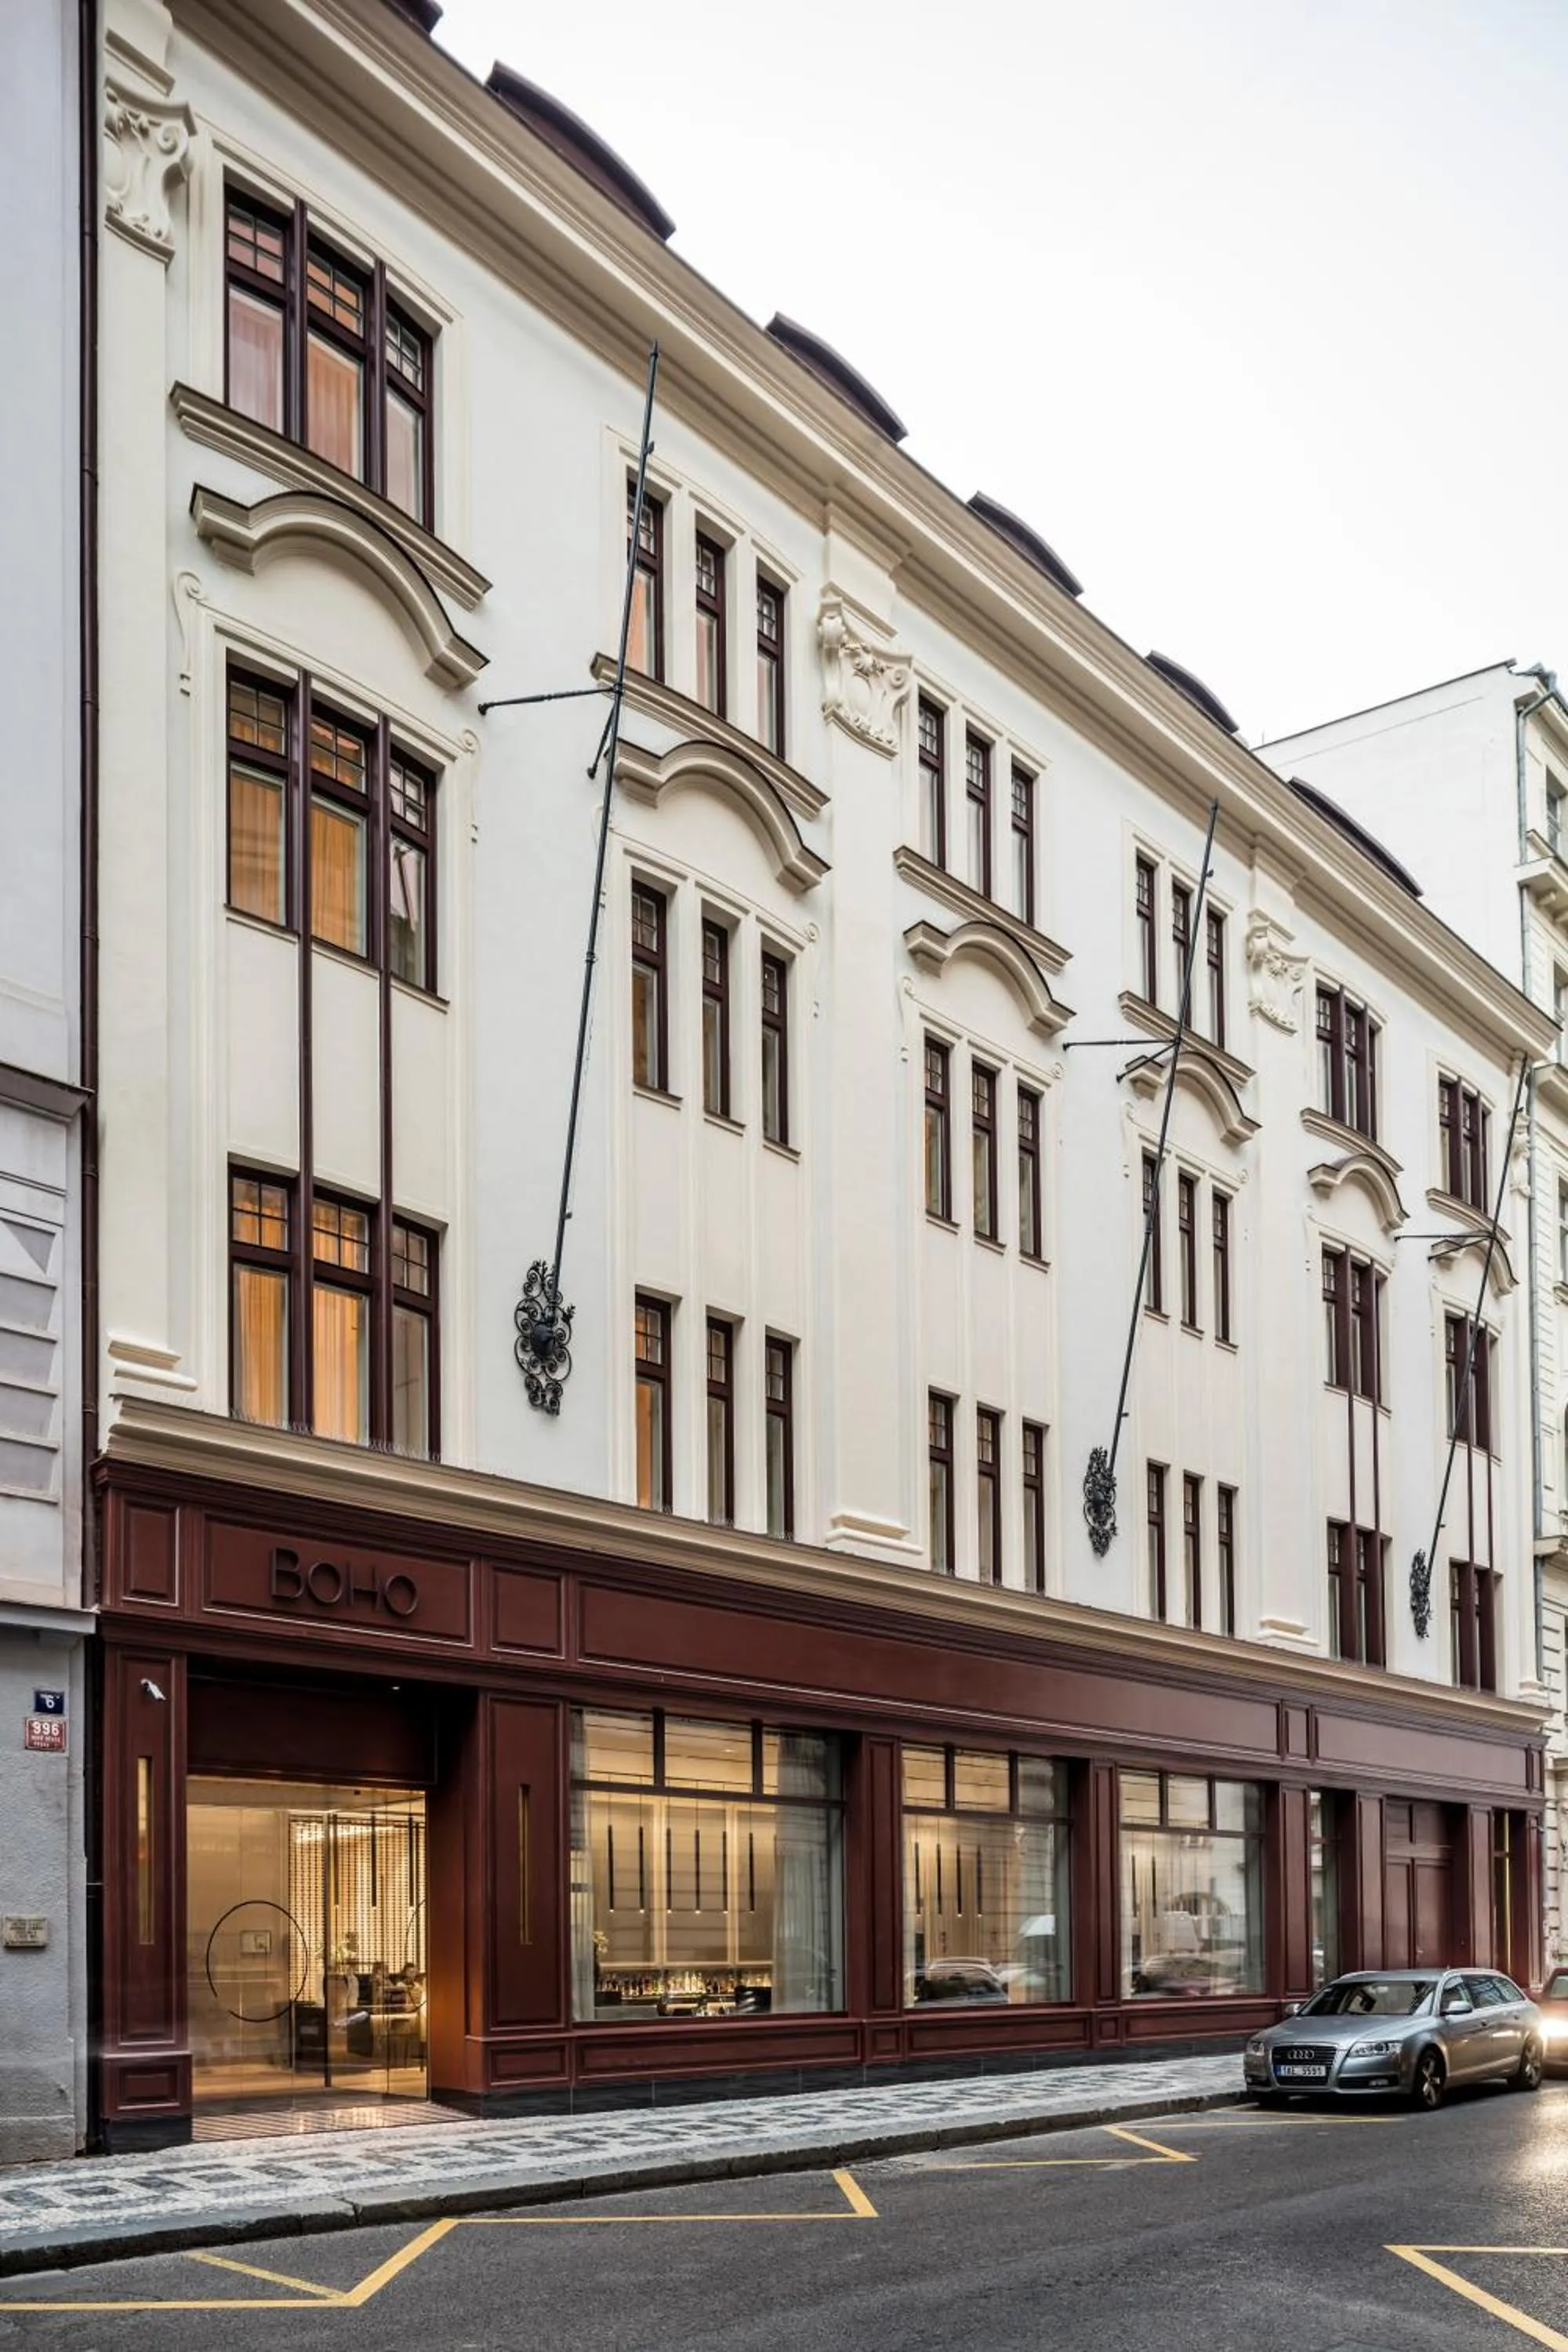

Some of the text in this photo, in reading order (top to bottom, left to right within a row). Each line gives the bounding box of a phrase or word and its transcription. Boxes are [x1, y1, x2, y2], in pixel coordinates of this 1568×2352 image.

[270, 1547, 419, 1616] BOHO
[45, 1696, 55, 1708] 6
[32, 1721, 60, 1737] 996
